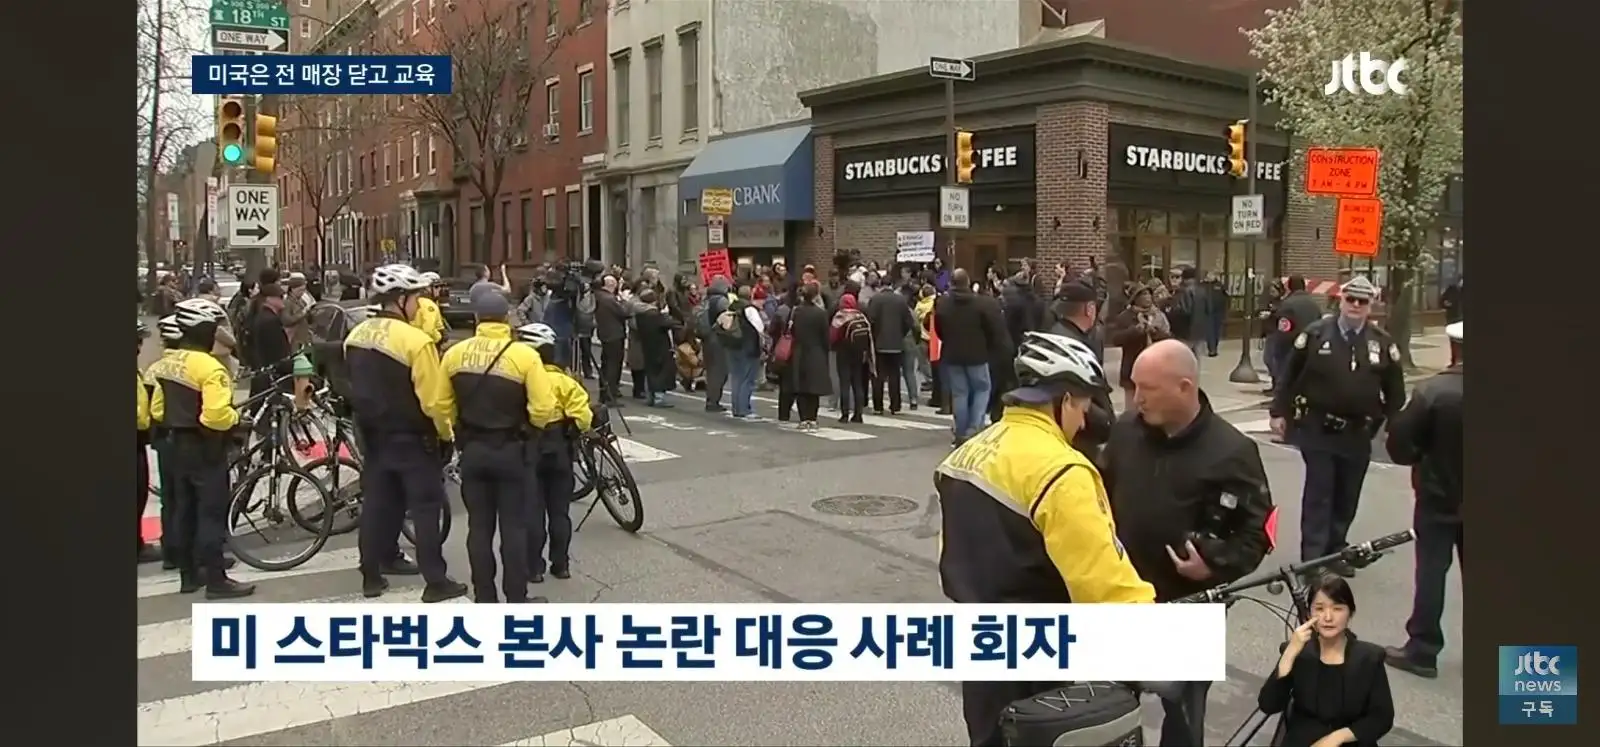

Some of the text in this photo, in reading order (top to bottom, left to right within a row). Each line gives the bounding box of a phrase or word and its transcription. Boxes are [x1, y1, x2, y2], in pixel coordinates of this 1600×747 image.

[270, 17, 286, 27] ST
[220, 31, 267, 44] ONE WAY
[1126, 145, 1226, 175] STARBUCKS
[1311, 154, 1374, 165] CONSTRUCTION
[845, 154, 941, 181] STARBUCKS
[1329, 168, 1352, 177] ZONE
[236, 190, 269, 205] ONE
[744, 183, 781, 205] BANK
[949, 192, 960, 201] NO
[1241, 200, 1253, 208] NO
[236, 208, 270, 222] WAY
[1237, 210, 1258, 218] TURN
[1233, 220, 1261, 230] ON RED
